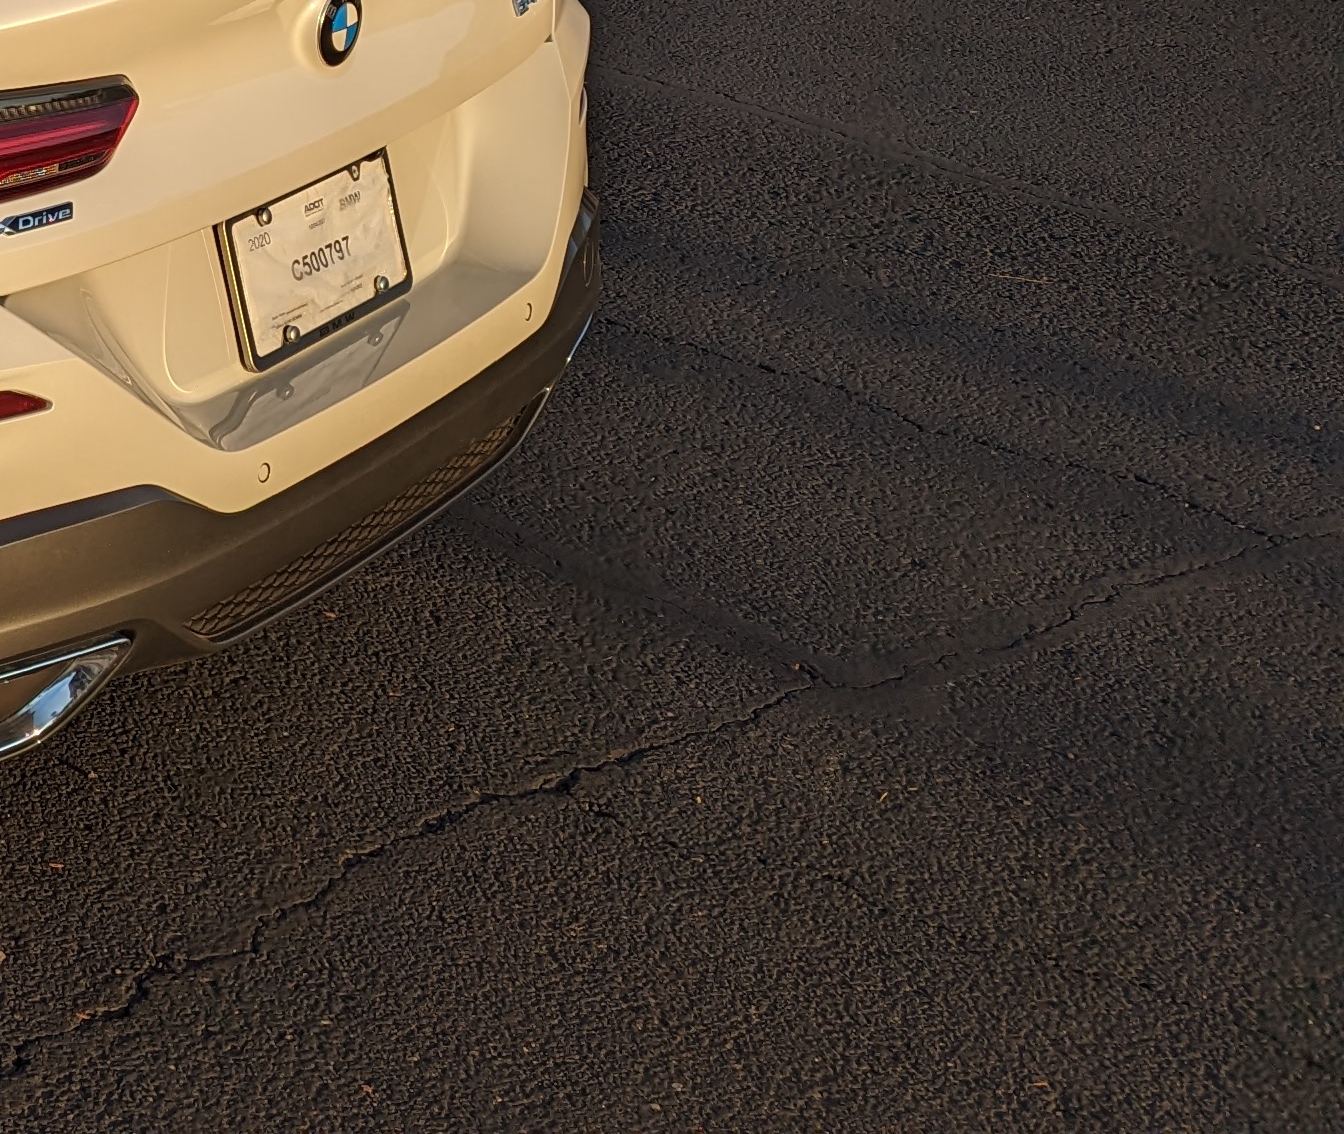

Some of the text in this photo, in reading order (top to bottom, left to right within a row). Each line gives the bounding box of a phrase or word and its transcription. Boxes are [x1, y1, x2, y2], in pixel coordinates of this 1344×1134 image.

[248, 231, 271, 252] 2020
[291, 235, 351, 281] C500797
[319, 311, 355, 337] BMW
